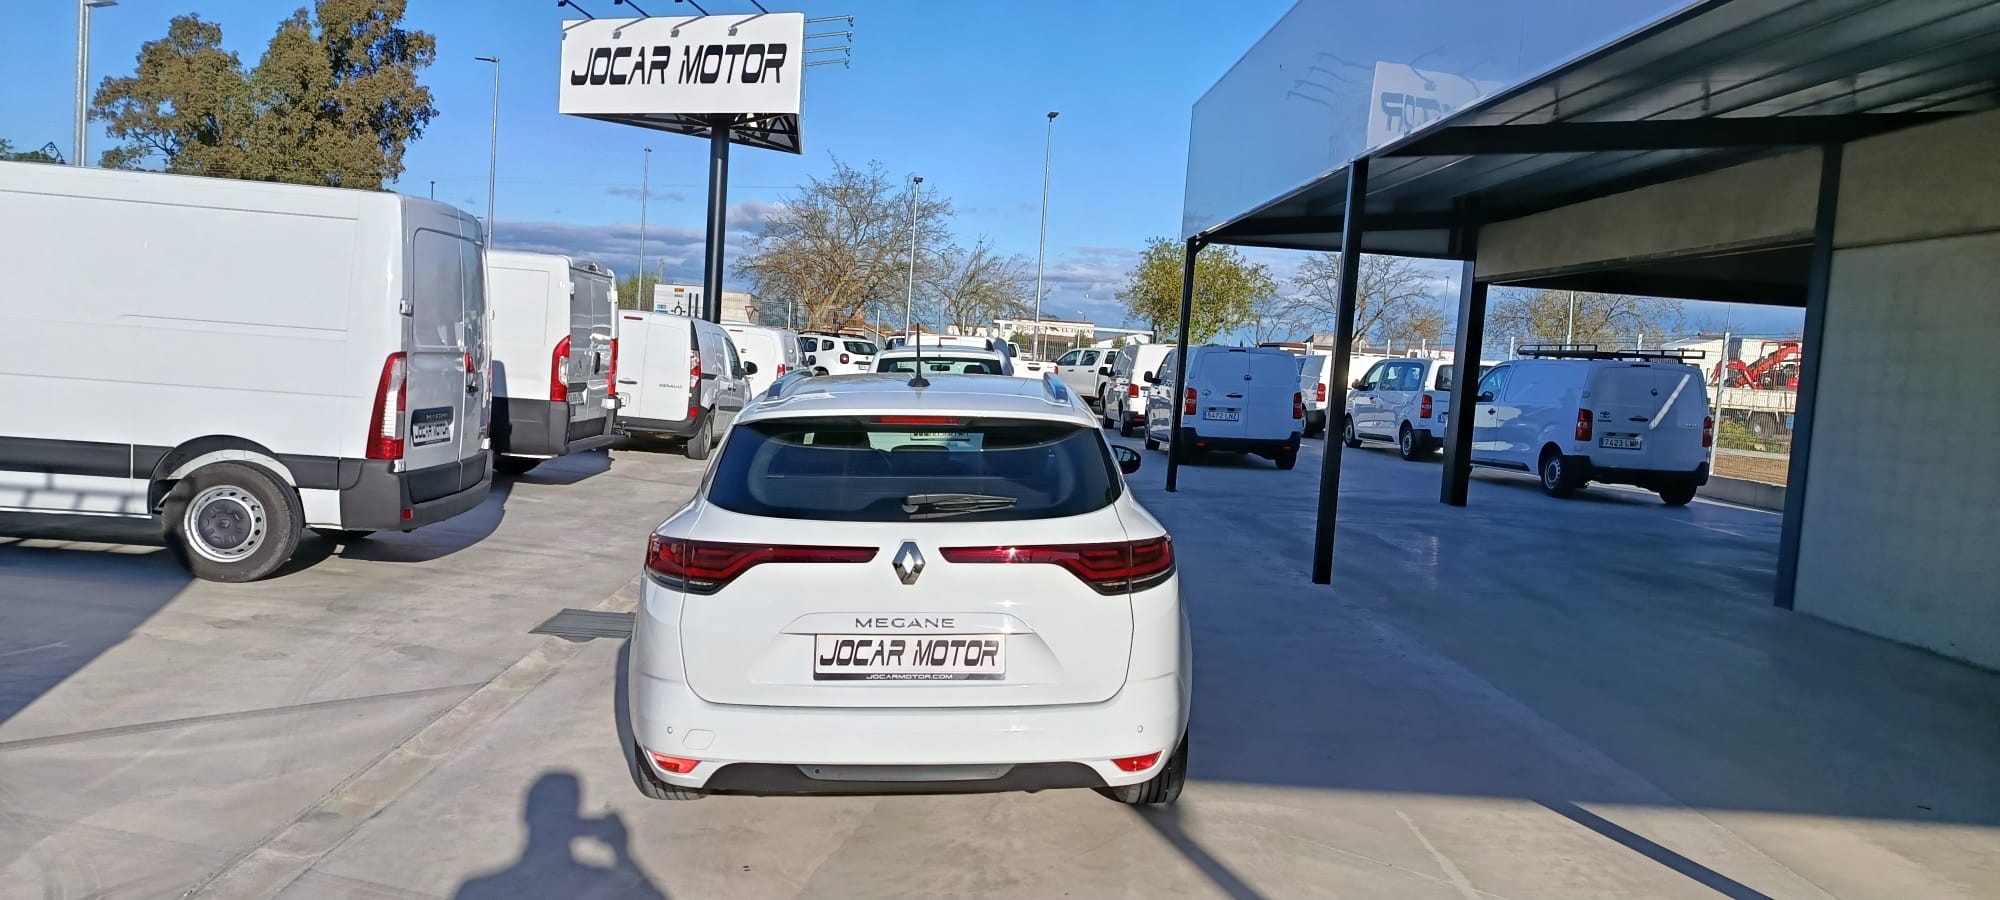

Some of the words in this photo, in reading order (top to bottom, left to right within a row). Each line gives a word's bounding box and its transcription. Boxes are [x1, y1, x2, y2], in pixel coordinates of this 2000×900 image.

[571, 46, 671, 86] JOCAR
[678, 43, 787, 85] MOTOR
[855, 618, 955, 628] MEGANE
[820, 640, 906, 666] JOCAR
[912, 640, 999, 666] MOTOR
